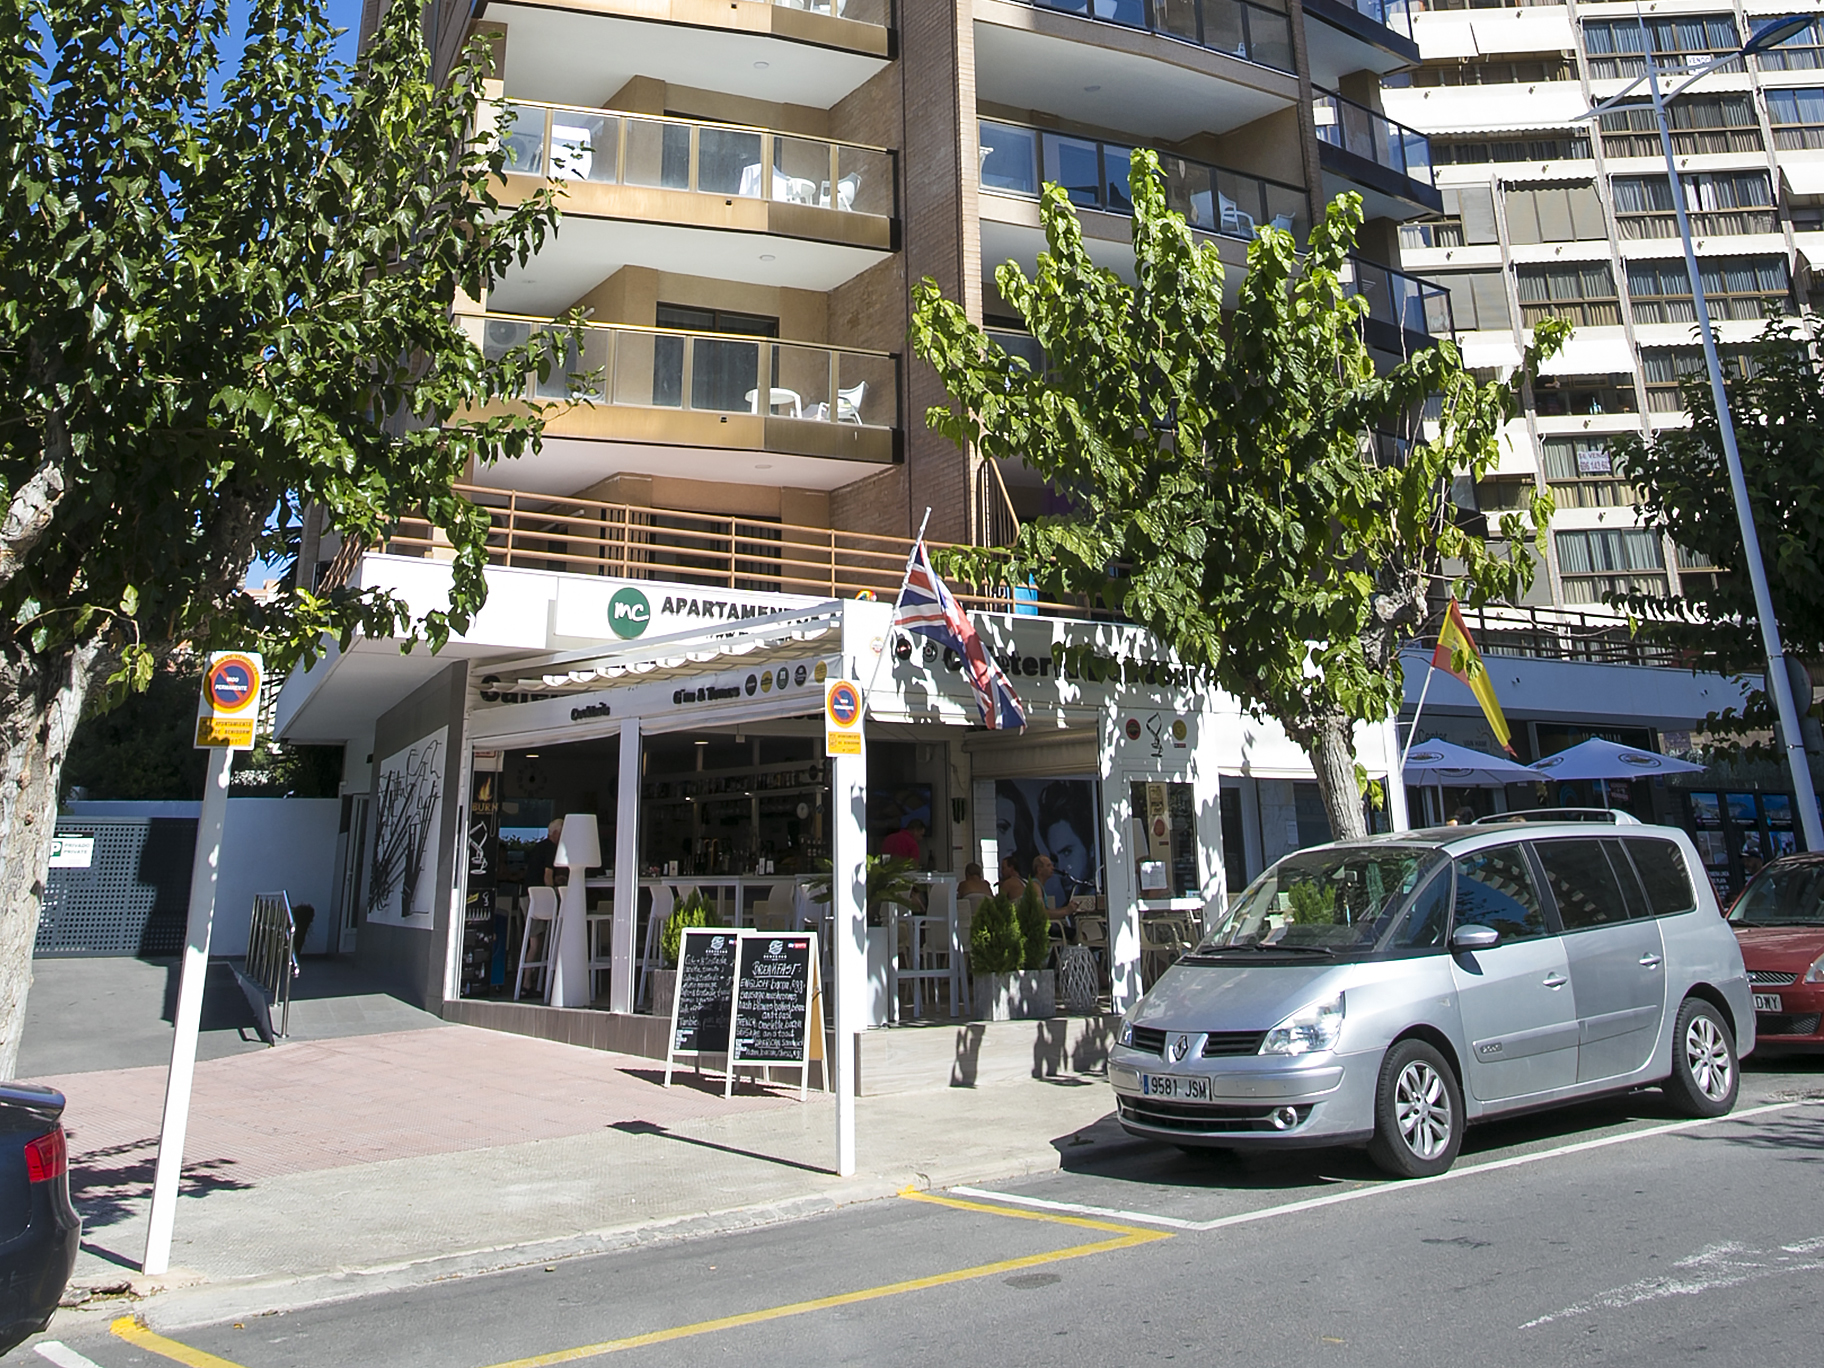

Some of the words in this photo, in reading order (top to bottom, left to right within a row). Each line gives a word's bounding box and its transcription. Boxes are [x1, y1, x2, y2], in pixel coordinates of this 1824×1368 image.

[661, 595, 797, 621] APARTAME
[1151, 1076, 1178, 1096] 9581
[1184, 1080, 1207, 1099] JSM
